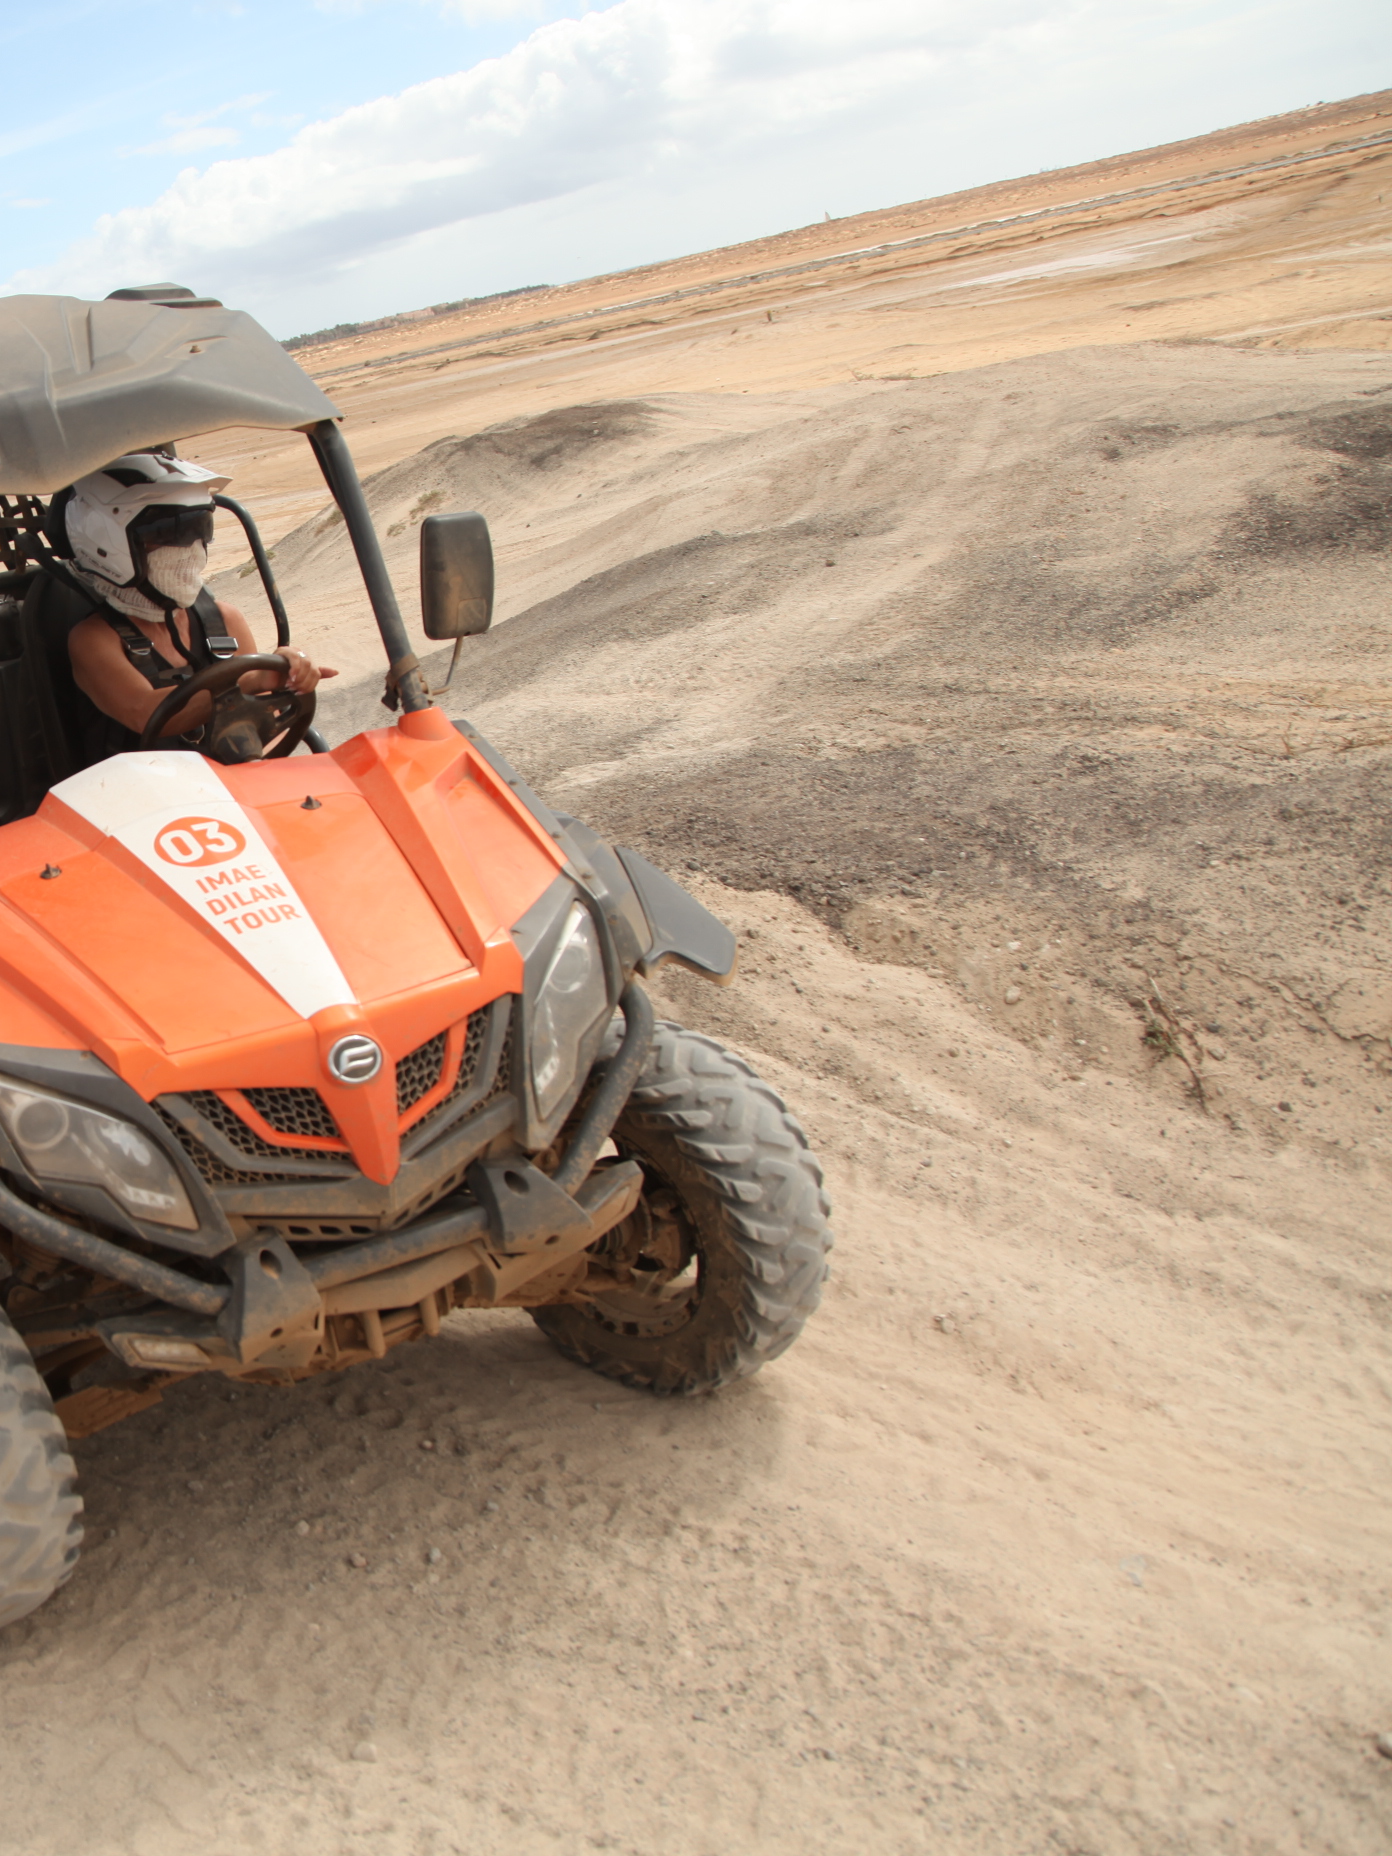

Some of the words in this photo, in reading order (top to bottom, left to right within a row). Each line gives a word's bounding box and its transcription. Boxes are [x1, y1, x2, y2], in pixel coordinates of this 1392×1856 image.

[159, 821, 238, 864] 03
[195, 864, 266, 894] IMAE
[205, 883, 287, 916] DILAN
[223, 904, 302, 935] TOUR
